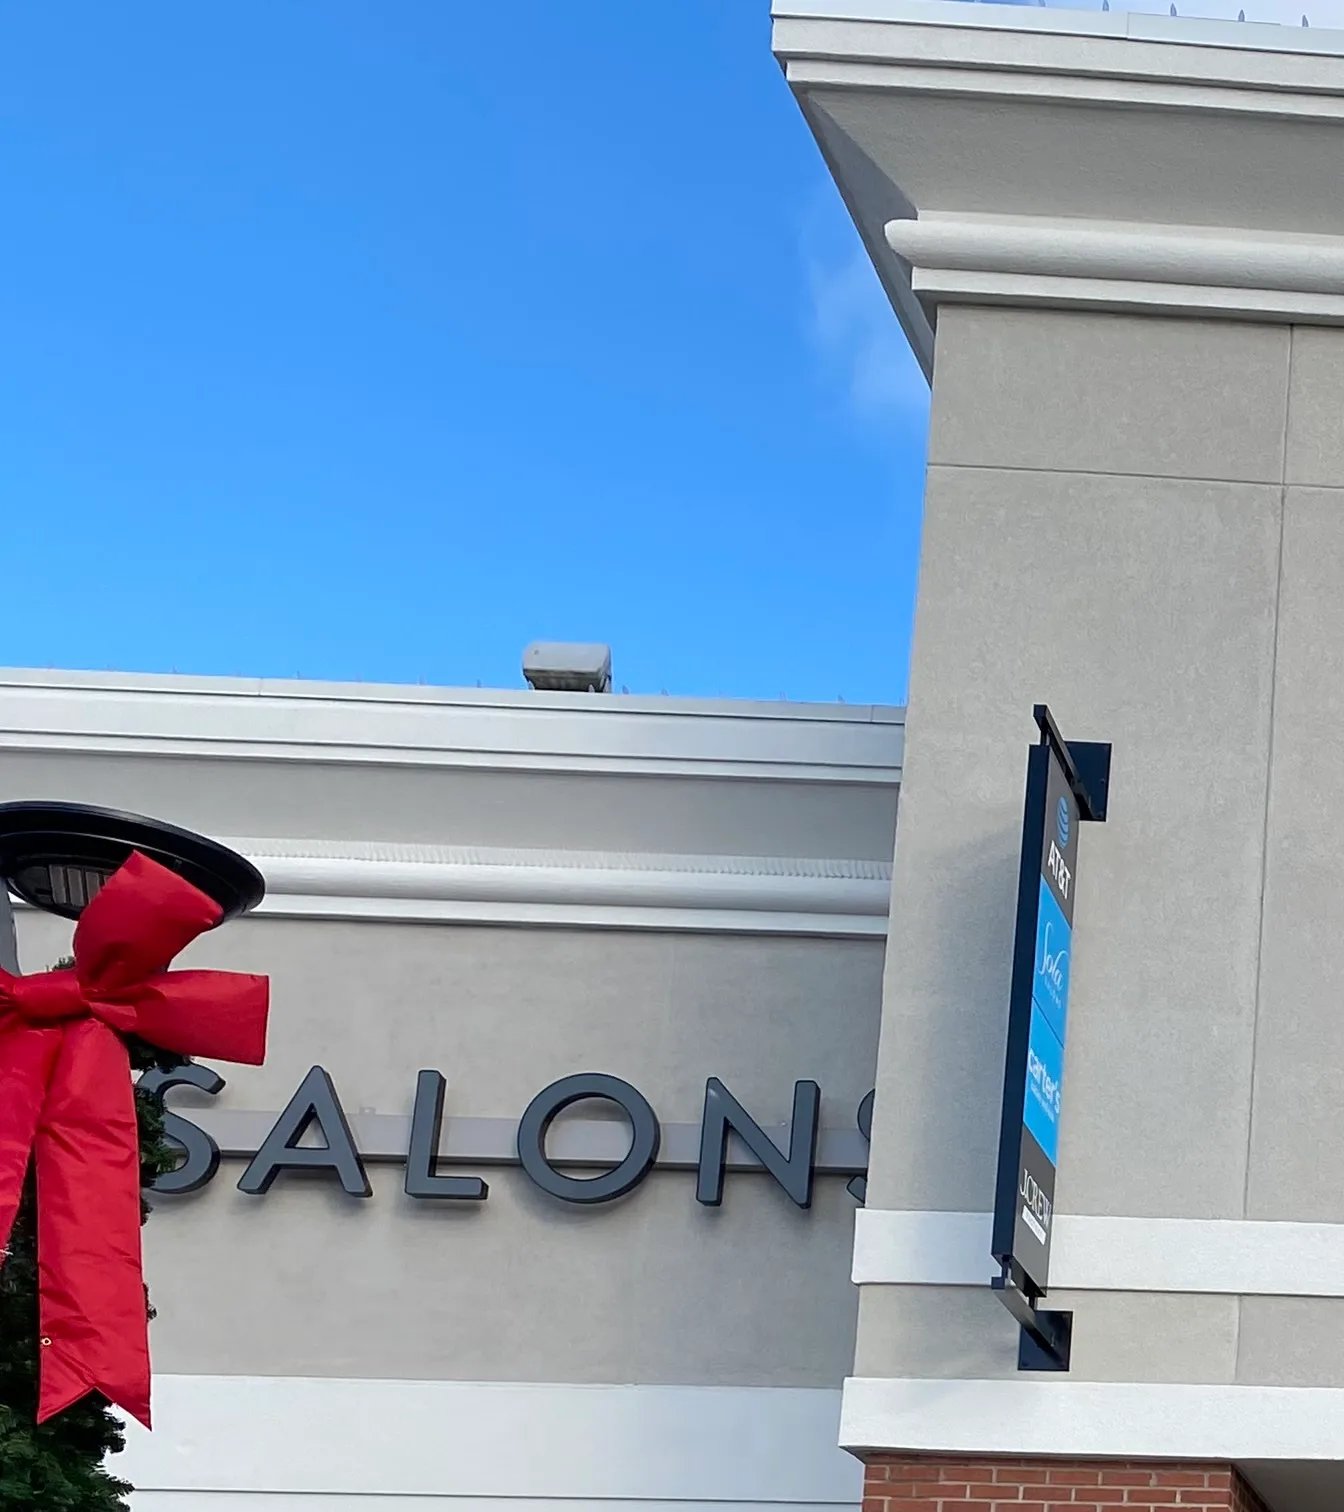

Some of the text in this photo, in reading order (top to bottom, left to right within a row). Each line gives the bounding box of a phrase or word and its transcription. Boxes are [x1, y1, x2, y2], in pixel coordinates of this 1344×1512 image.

[1047, 840, 1071, 899] AT&T
[1038, 921, 1068, 991] Sola
[1028, 1048, 1061, 1114] carter's
[134, 1063, 875, 1210] SALON
